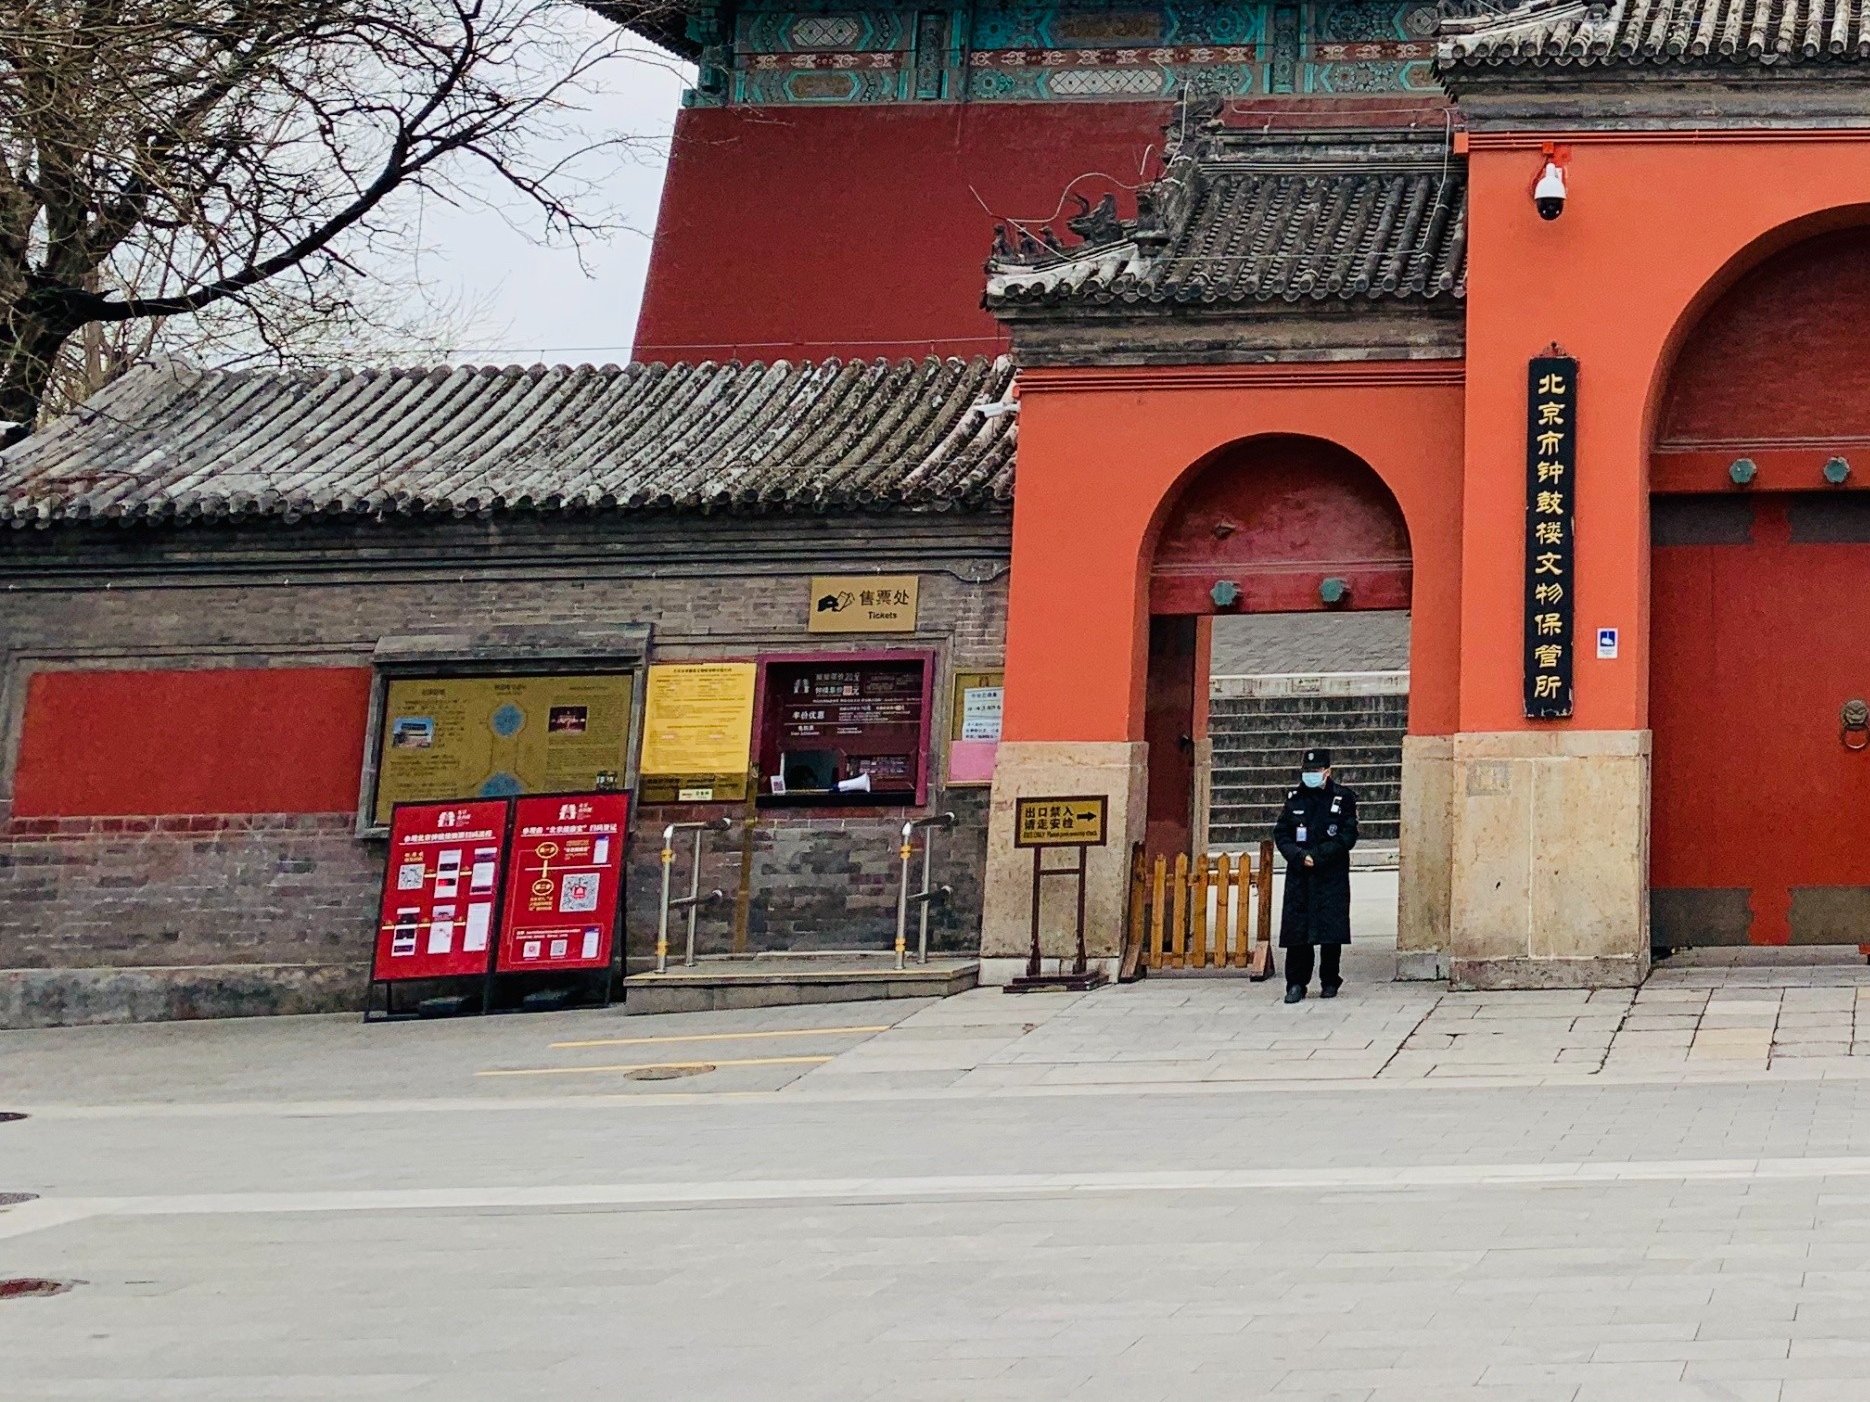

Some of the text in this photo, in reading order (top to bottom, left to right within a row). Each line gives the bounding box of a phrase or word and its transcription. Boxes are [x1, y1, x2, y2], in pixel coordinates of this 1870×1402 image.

[1534, 372, 1566, 699] 北京市钟鼓楼文物保管所
[859, 589, 910, 606] 售票处
[868, 611, 898, 619] Tickets
[1025, 806, 1074, 819] 出口禁入
[1025, 818, 1074, 830] 请走安检
